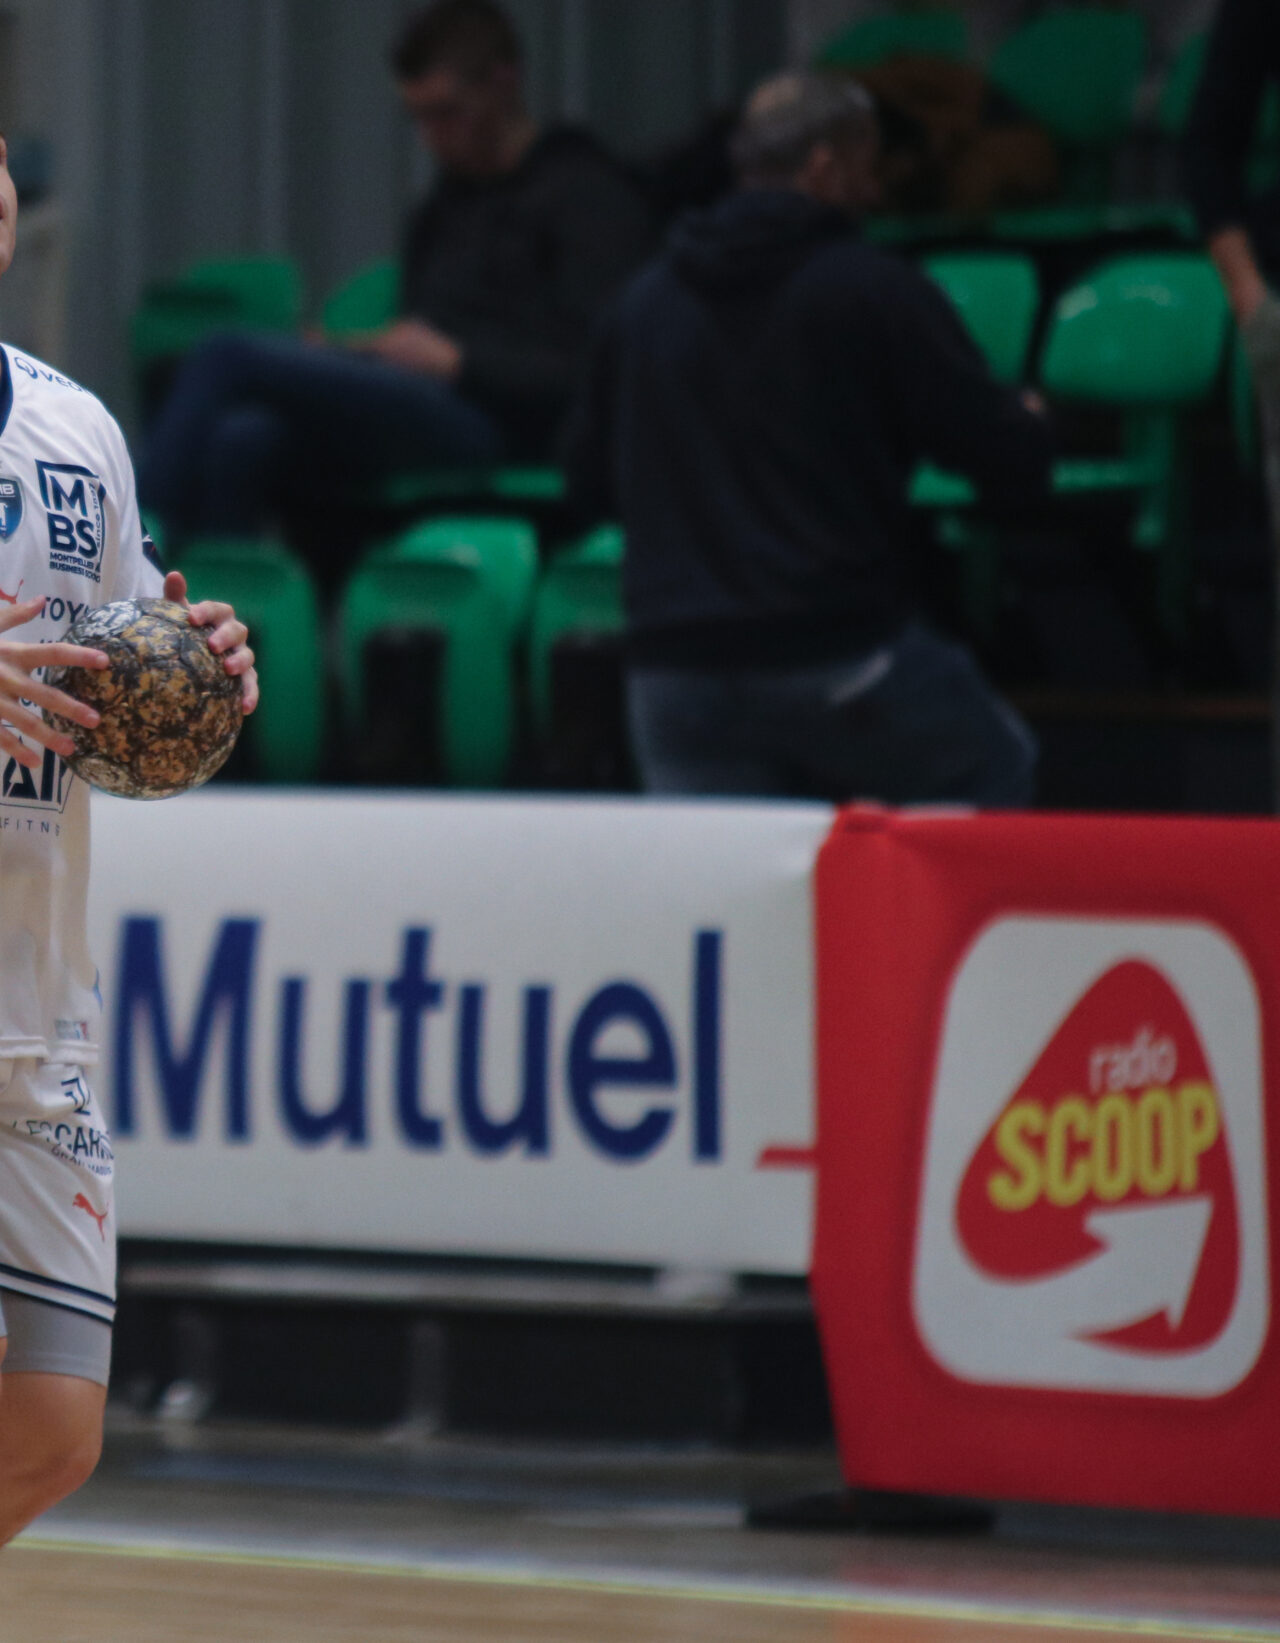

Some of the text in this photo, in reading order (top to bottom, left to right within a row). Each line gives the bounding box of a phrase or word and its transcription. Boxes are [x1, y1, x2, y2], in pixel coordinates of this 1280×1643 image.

[112, 915, 724, 1165] Mutuel
[1088, 1026, 1177, 1093] radio
[987, 1081, 1219, 1212] SCOOP
